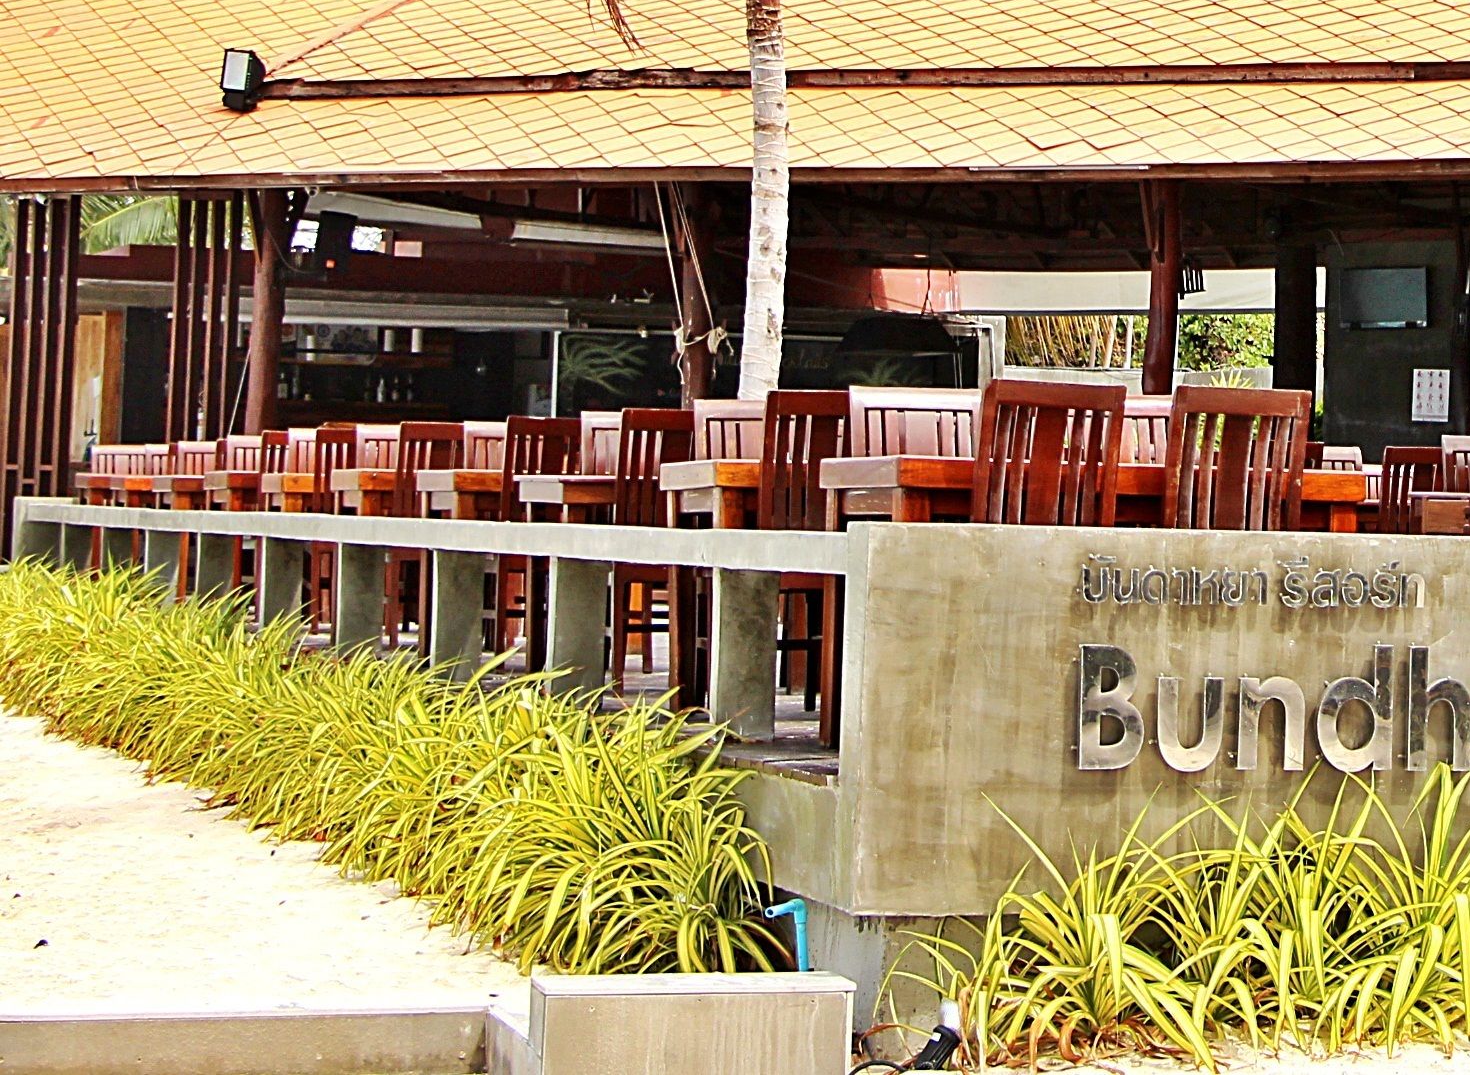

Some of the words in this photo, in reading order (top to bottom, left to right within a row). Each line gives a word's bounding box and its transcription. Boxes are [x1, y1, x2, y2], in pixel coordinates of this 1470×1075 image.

[1080, 554, 1268, 607] บันดาหยา
[1278, 555, 1425, 609] รีสอร์ท
